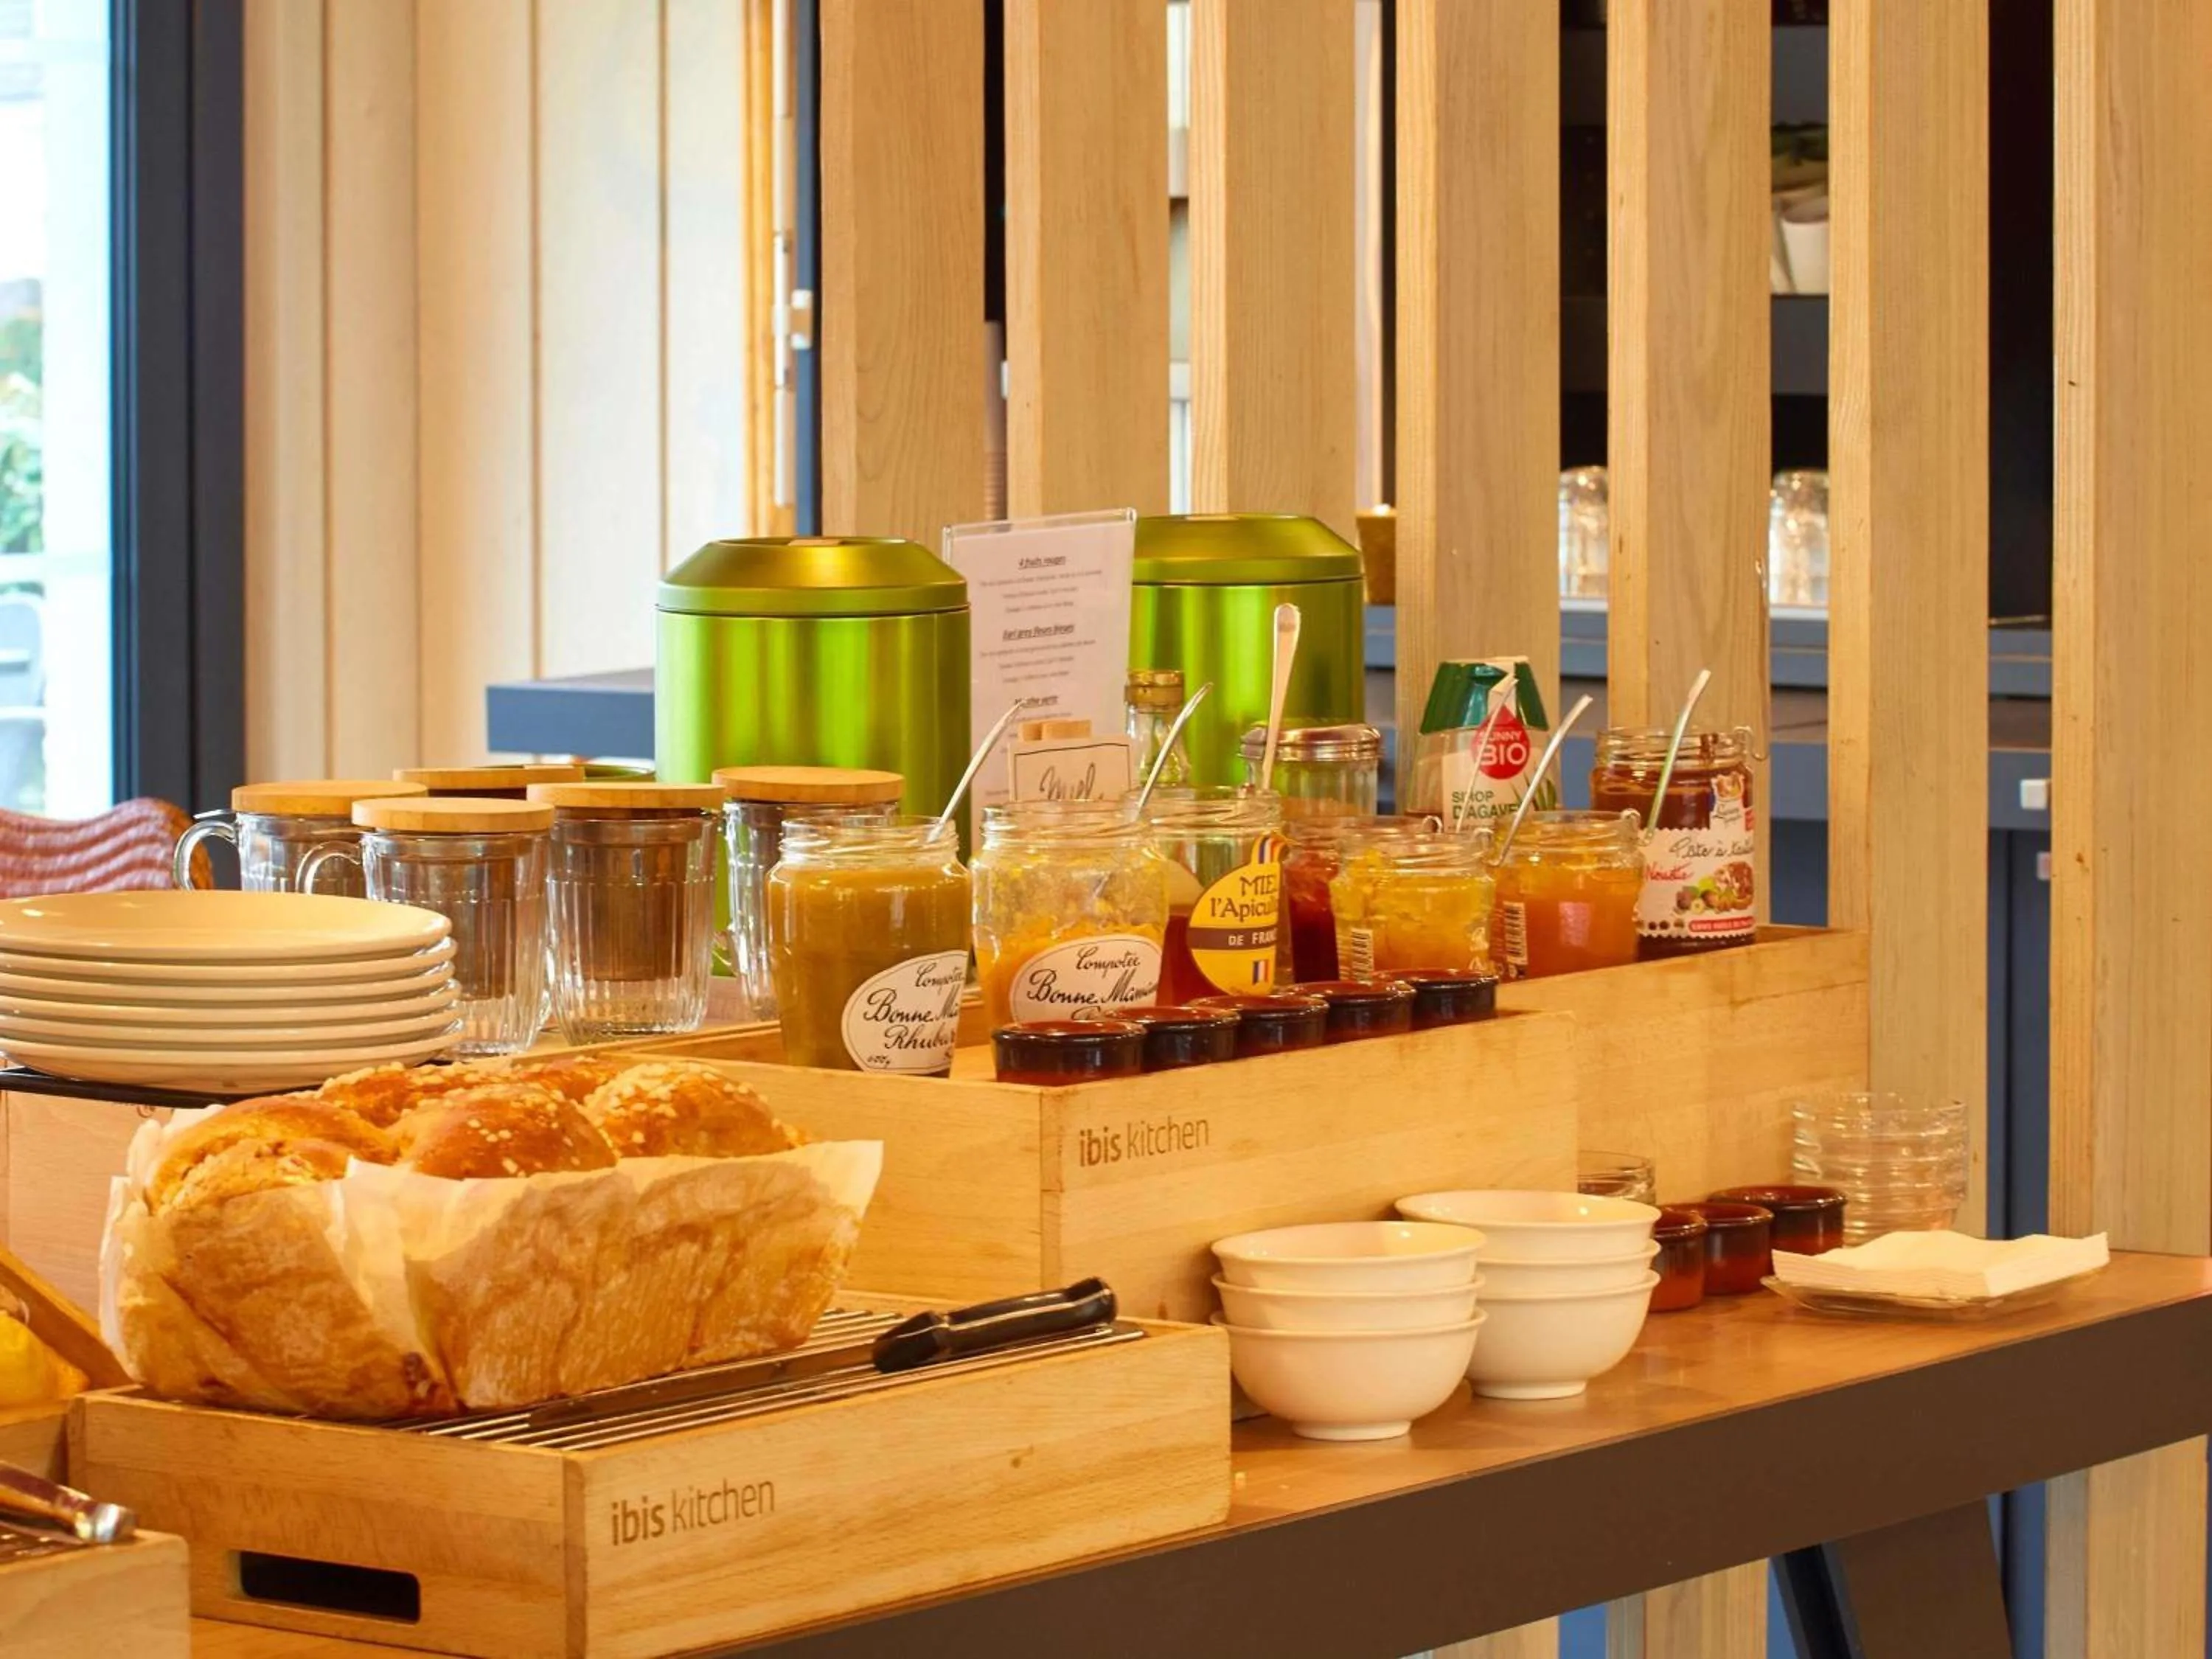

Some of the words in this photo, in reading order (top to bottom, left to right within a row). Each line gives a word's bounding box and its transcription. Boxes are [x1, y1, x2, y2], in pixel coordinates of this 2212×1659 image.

[1481, 742, 1527, 765] BIO
[1453, 803, 1519, 820] DAGAVE
[1239, 874, 1279, 897] MIE
[1228, 935, 1245, 946] DE
[1027, 968, 1099, 1004] Bonne
[863, 988, 934, 1022] Bonne
[1079, 1124, 1122, 1167] ibis
[1127, 1116, 1209, 1159] kitchen
[611, 1495, 666, 1546] ibis
[672, 1477, 776, 1533] kitchen
